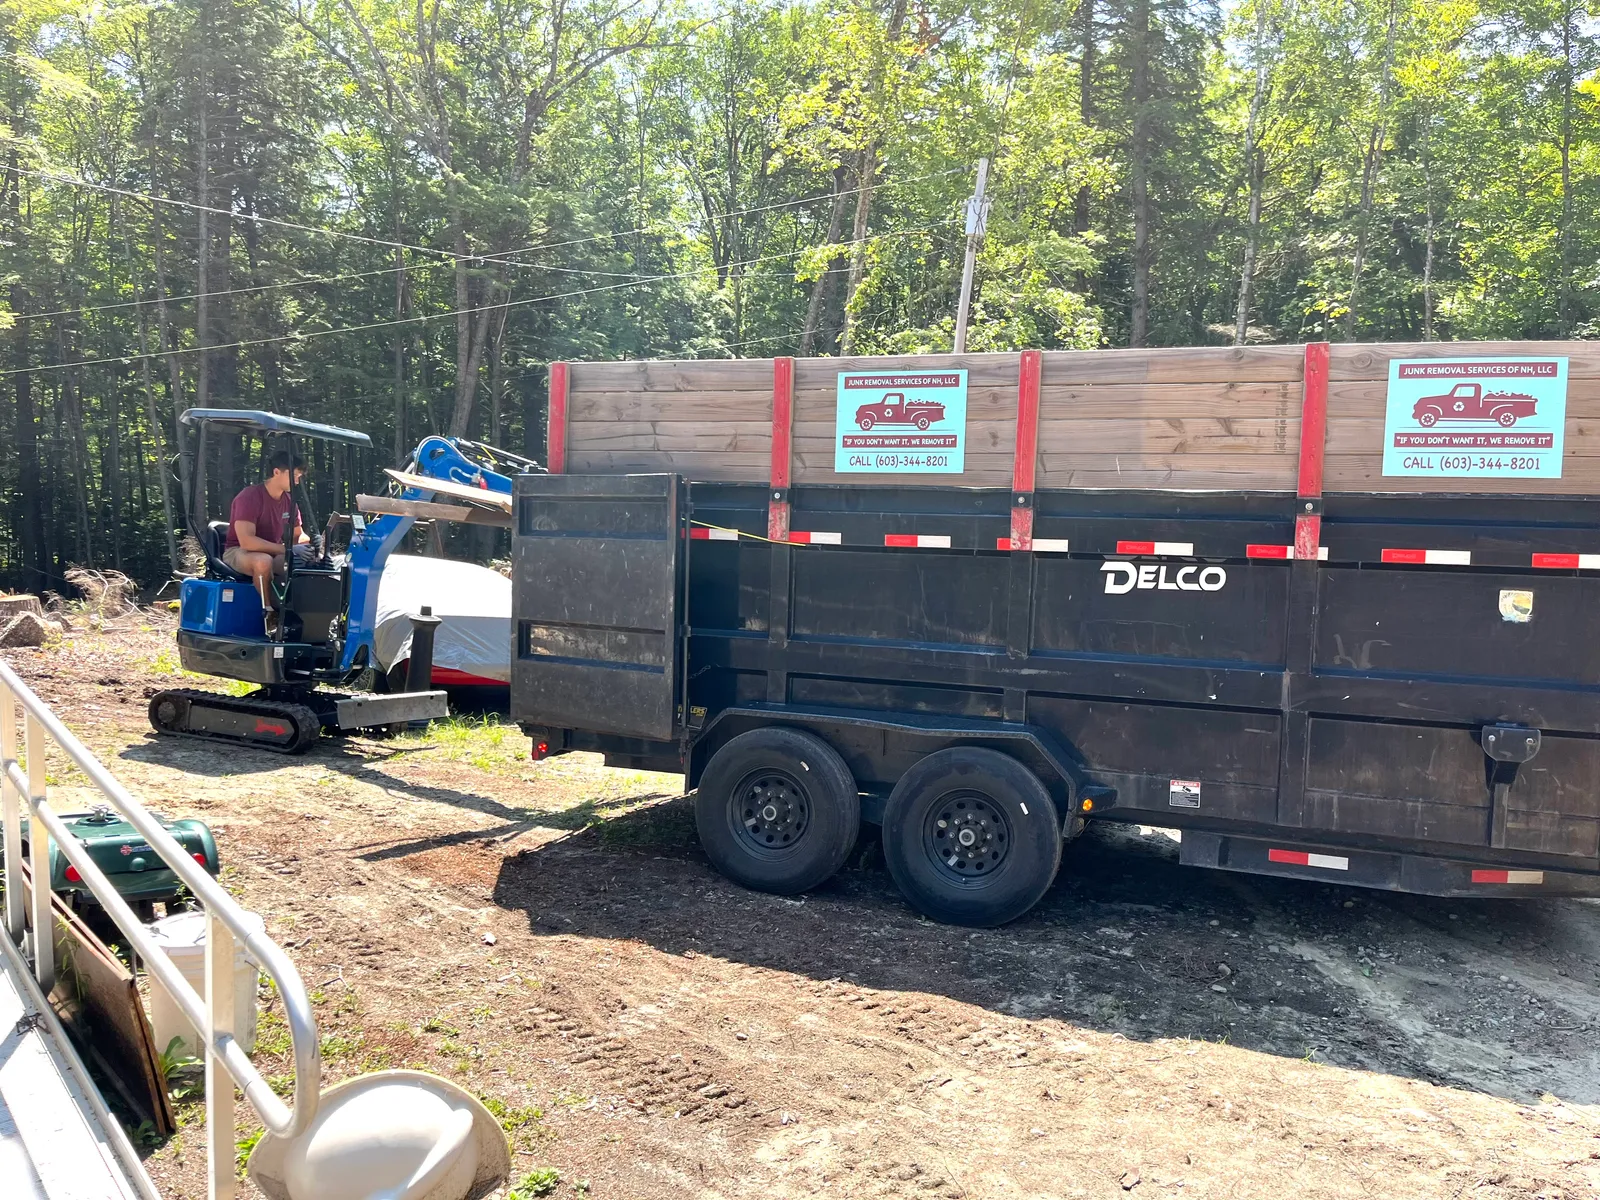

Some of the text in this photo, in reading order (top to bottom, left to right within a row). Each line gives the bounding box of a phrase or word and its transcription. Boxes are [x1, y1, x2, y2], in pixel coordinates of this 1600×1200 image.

[1403, 367, 1425, 375] JUNK
[1426, 367, 1466, 375] REMOVAL
[1467, 366, 1506, 374] SERVICES
[1520, 366, 1535, 375] NH,
[932, 378, 943, 386] NH,
[1428, 436, 1449, 444] DON'T
[1476, 437, 1487, 445] IT,
[849, 454, 948, 468] CALL (603)-344-8201
[1403, 456, 1540, 471] CALL (603)-344-8201
[1100, 561, 1227, 594] DELCO
